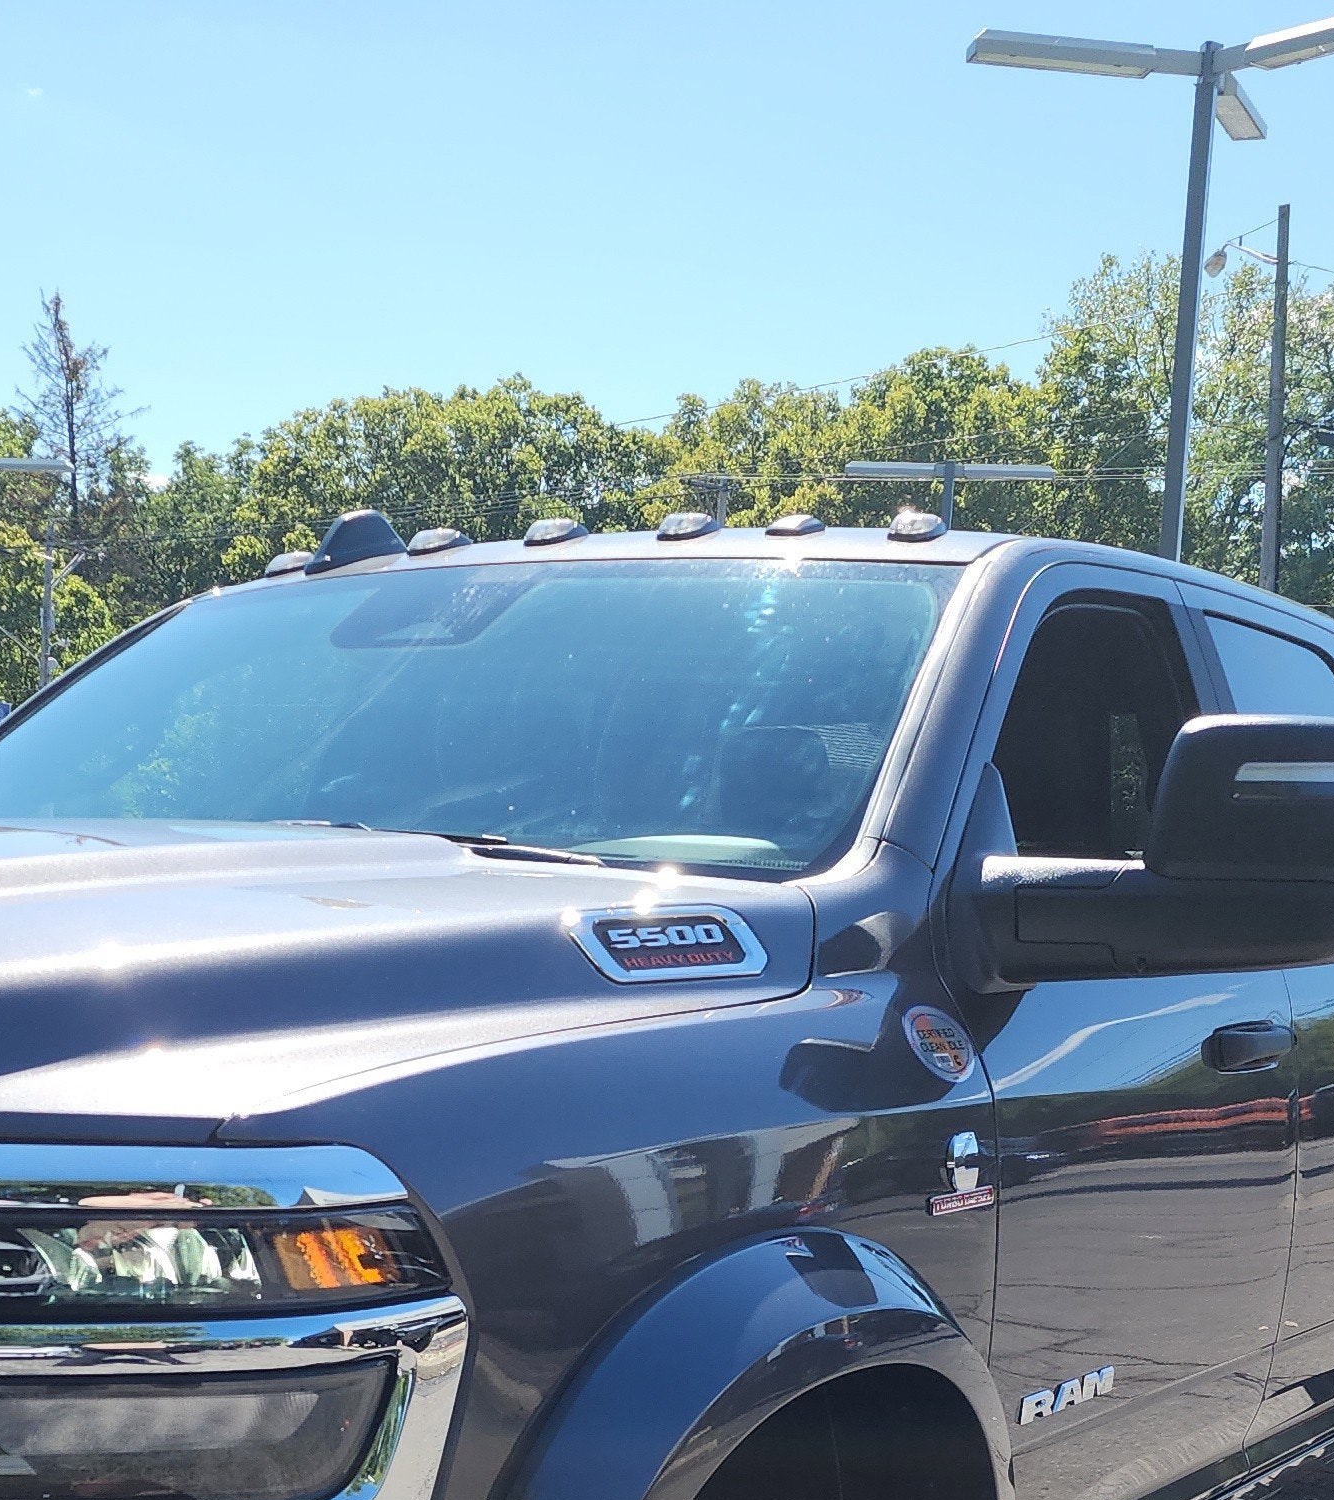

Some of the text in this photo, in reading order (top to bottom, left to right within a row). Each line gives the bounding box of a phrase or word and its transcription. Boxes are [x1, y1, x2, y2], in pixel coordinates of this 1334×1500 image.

[607, 923, 725, 949] 5500
[623, 951, 734, 969] HEAVY DUTY
[1016, 1365, 1115, 1425] RAM
